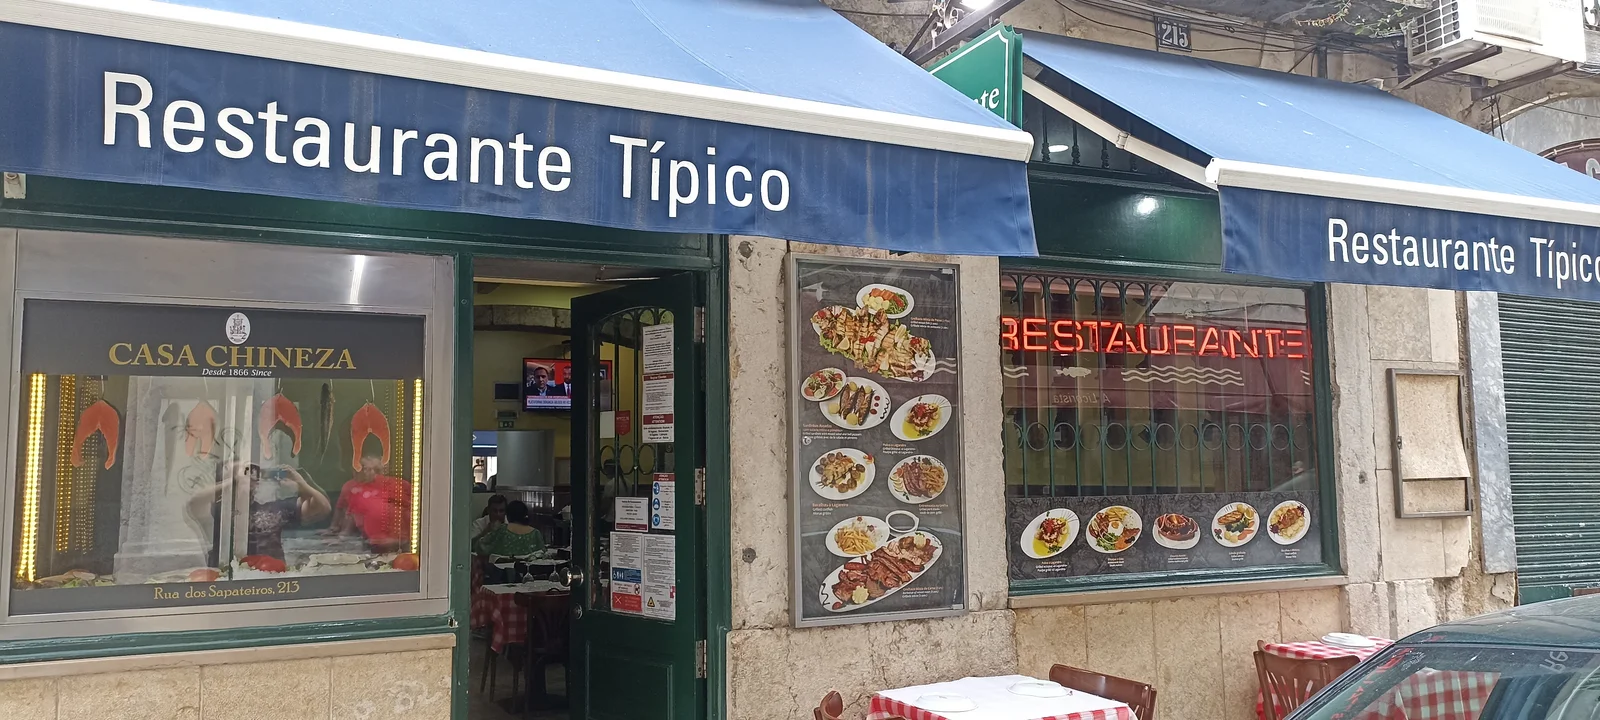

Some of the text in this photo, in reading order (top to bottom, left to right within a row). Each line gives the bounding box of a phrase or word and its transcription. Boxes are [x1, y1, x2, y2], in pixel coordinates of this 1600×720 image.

[1161, 21, 1188, 47] 215
[973, 87, 1000, 110] te
[104, 70, 791, 218] Restaurante Típico
[1328, 218, 1515, 275] Restaurante
[1001, 317, 1304, 358] RESTAURANTE
[108, 342, 356, 370] CASA CHINEZA
[202, 368, 272, 377] Desde 1866 Since
[154, 581, 300, 600] Rua dos Sapateiros, 213
